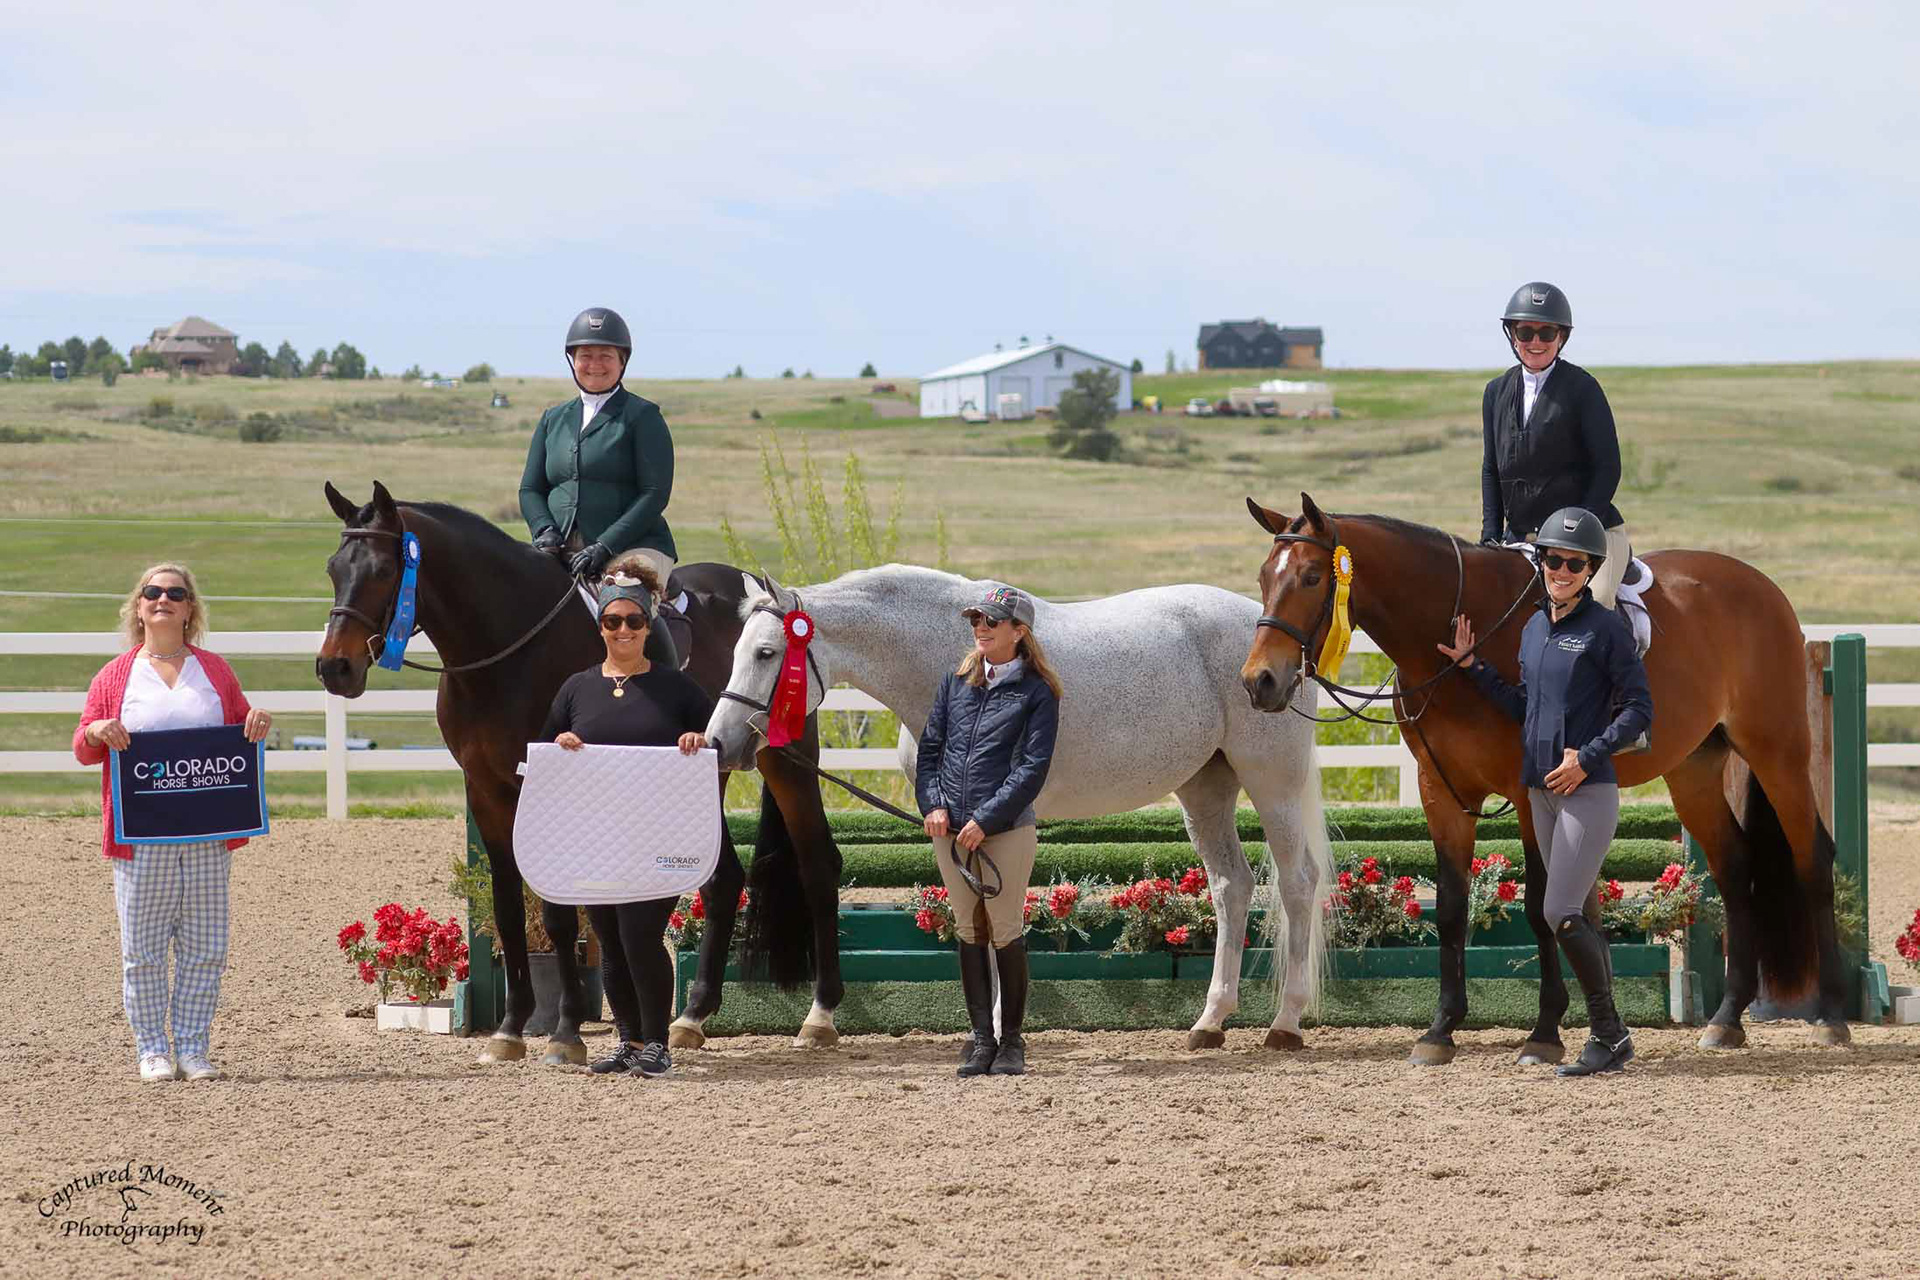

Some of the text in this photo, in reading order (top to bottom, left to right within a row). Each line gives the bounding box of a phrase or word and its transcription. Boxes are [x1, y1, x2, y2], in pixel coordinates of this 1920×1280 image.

[134, 756, 246, 779] COLORADO
[153, 775, 230, 789] HORSE SHOWS
[656, 856, 700, 865] COLORADO
